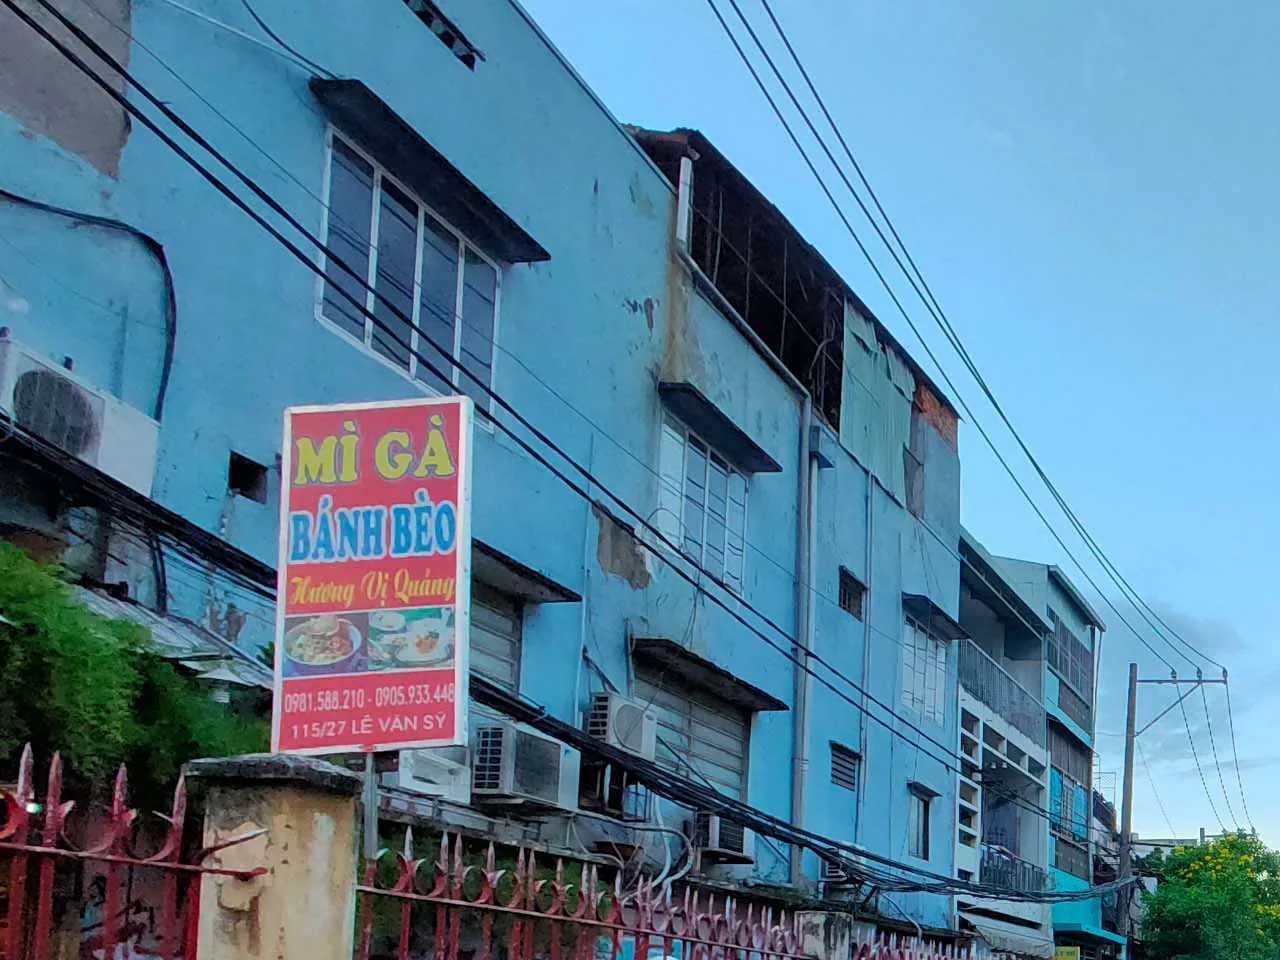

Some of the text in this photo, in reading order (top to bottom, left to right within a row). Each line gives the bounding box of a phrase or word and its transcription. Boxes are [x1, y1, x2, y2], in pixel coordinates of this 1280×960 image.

[293, 413, 457, 487] MÌ GÀ
[288, 488, 457, 565] BÁNH BÈO
[290, 566, 456, 608] Hương Vị Quảng
[284, 688, 365, 713] 0981.588.210
[291, 711, 447, 740] 115/27 LÊ VĂN SỸ
